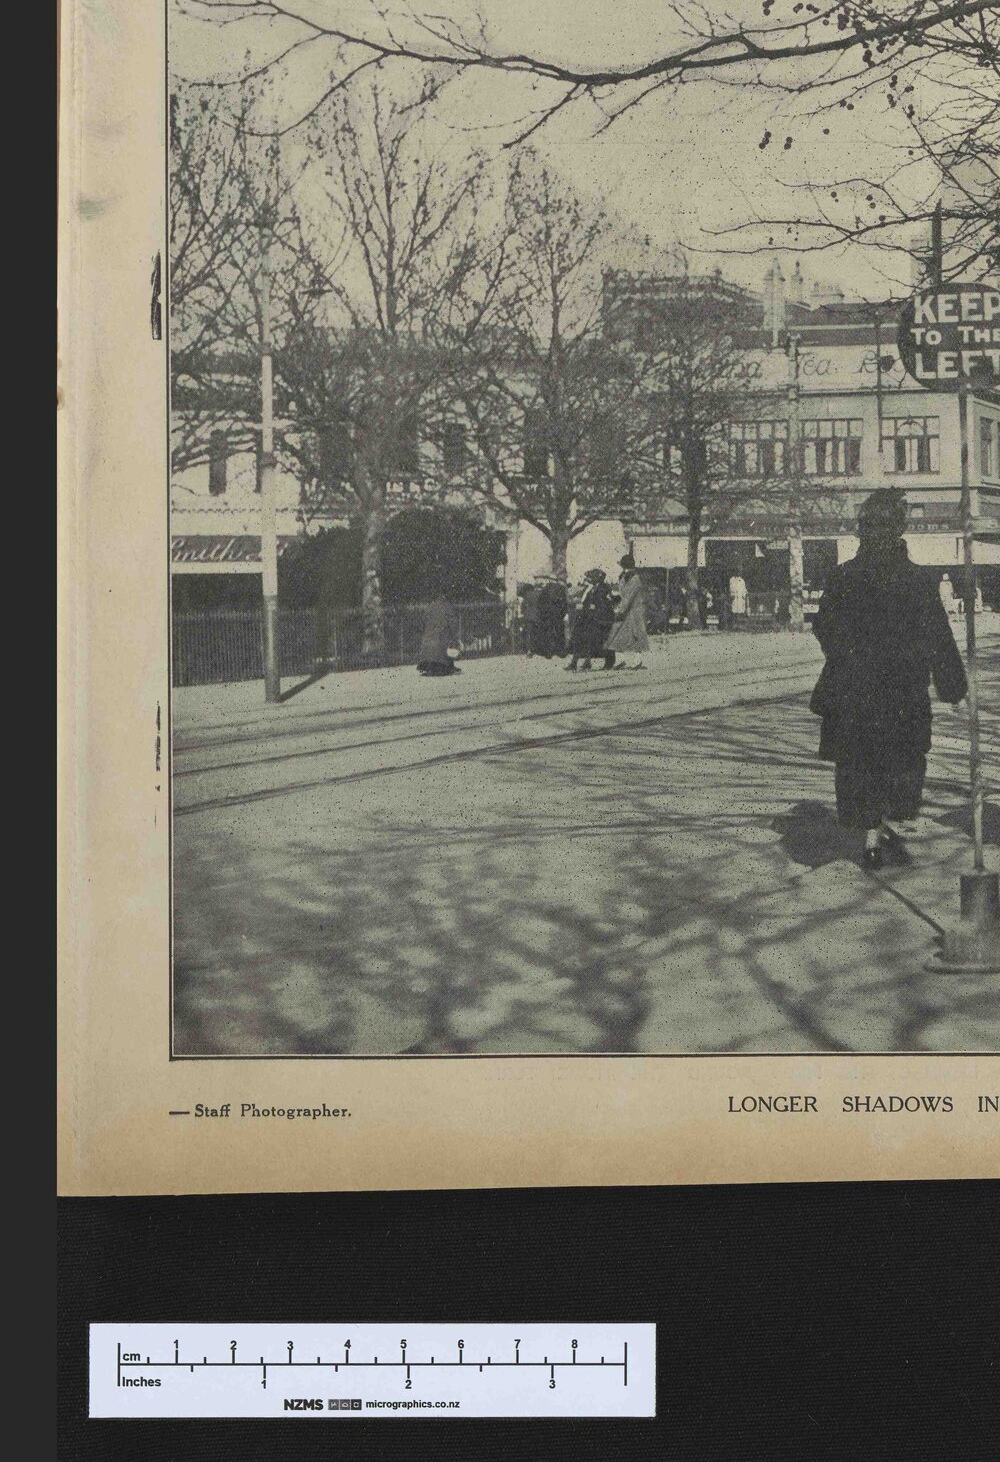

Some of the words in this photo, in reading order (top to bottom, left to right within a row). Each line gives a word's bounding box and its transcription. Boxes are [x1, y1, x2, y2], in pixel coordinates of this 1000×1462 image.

[910, 328, 942, 346] TO
[728, 1095, 819, 1113] LONGER
[842, 1095, 954, 1113] SHADOWS
[977, 1095, 1000, 1113] IN
[240, 1103, 352, 1120] Photographer.
[173, 1339, 179, 1349] 1
[230, 1340, 237, 1350] 2
[287, 1340, 294, 1350] 3
[344, 1339, 352, 1349] 4
[400, 1339, 407, 1349] 5
[457, 1339, 465, 1349] 6
[514, 1339, 521, 1349] 7
[571, 1339, 578, 1349] 8
[122, 1353, 141, 1362] cm
[122, 1376, 162, 1388] Inches
[261, 1379, 267, 1389] 1
[405, 1380, 412, 1389] 2
[549, 1380, 556, 1389] 3
[283, 1398, 324, 1411] NZMS
[365, 1399, 460, 1412] micrographics.co.nz
